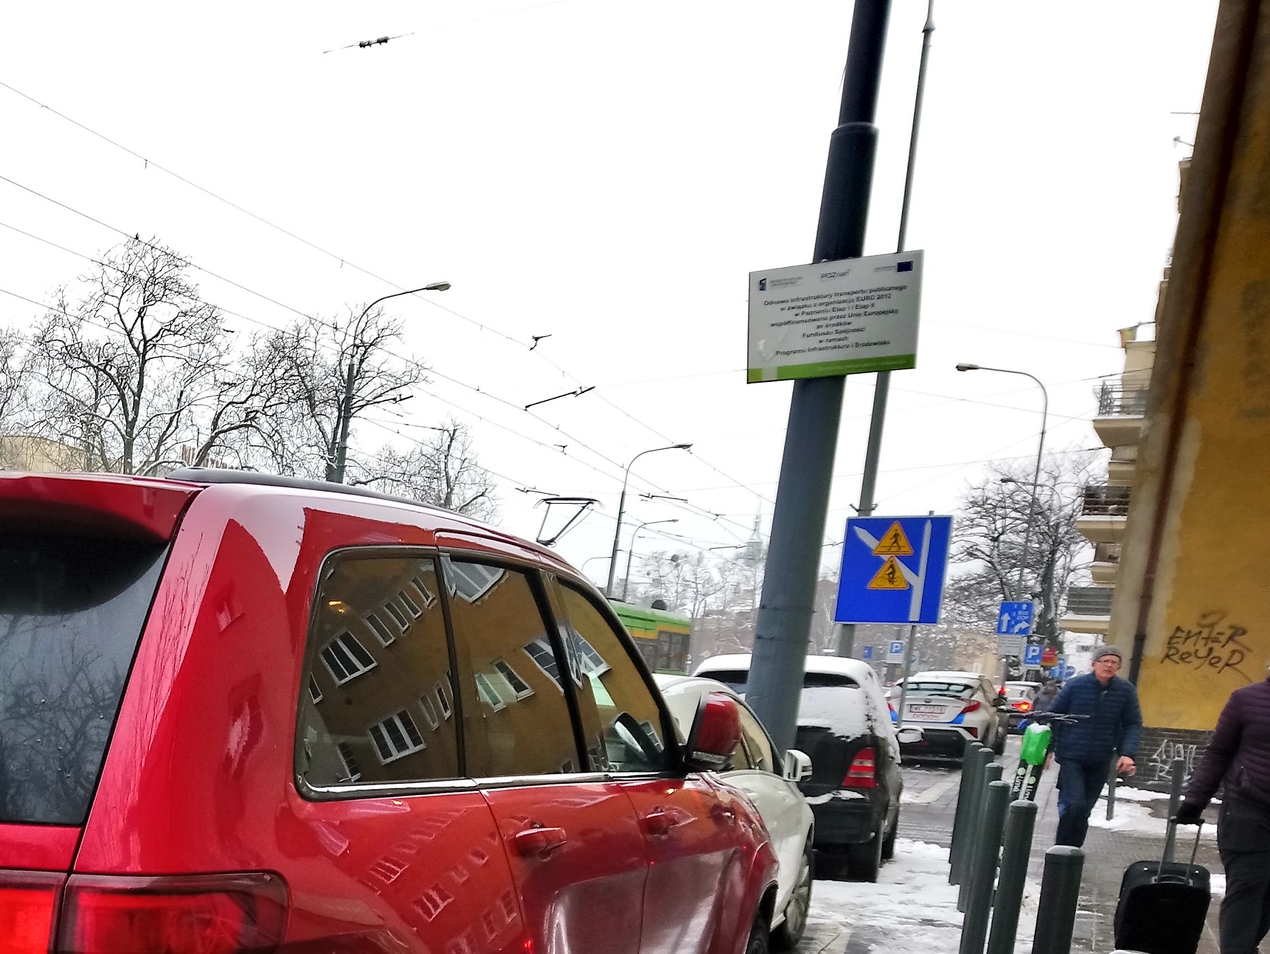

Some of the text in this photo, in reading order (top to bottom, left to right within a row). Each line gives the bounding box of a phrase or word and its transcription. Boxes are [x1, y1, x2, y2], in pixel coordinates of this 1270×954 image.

[835, 288, 868, 297] transportu
[870, 285, 907, 294] publicznego
[801, 308, 831, 316] Poznaniu
[832, 305, 847, 313] Etap
[830, 313, 847, 321] przez
[802, 330, 834, 338] Funduszu
[775, 348, 807, 356] Programu
[892, 643, 901, 653] P
[1029, 646, 1040, 659] P
